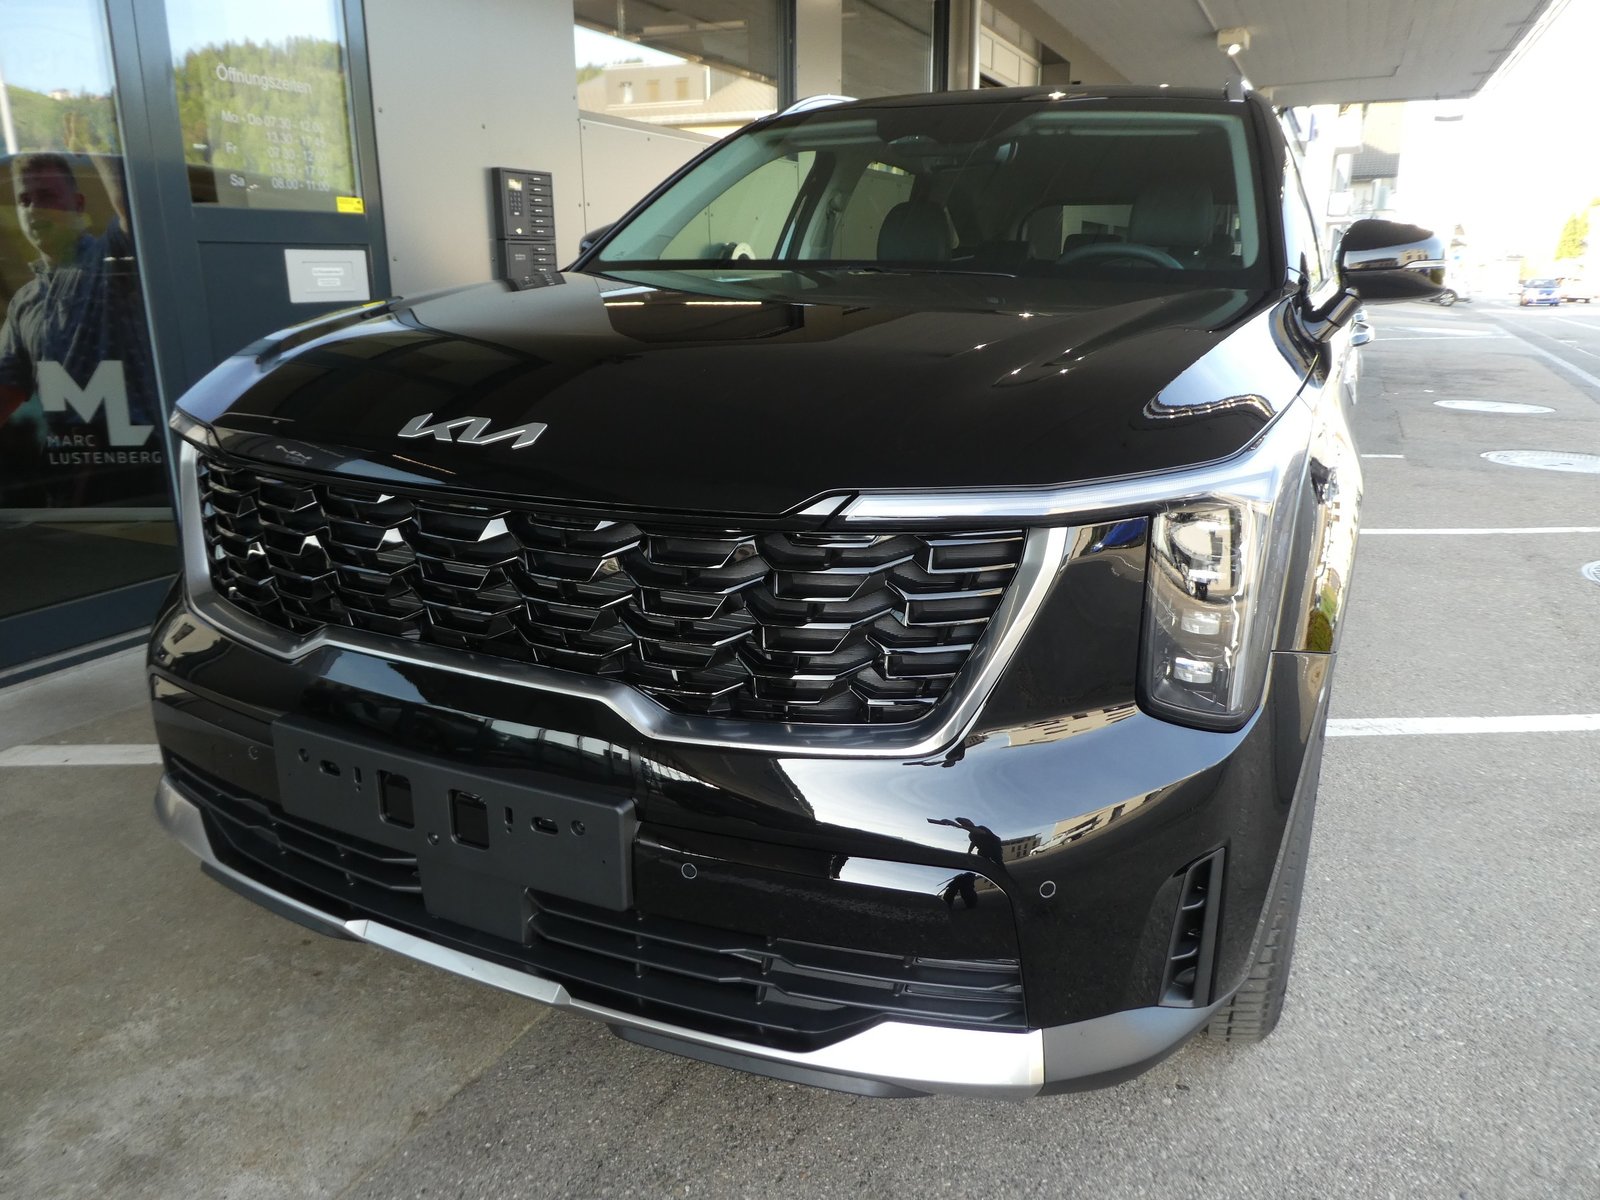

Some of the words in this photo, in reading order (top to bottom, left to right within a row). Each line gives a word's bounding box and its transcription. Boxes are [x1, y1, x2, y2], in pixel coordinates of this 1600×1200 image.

[216, 62, 312, 94] Öffnungszeiten
[221, 109, 240, 123] Mo
[246, 113, 263, 126] Do
[224, 141, 238, 155] Fr
[229, 174, 245, 187] Sa
[37, 360, 155, 446] ML
[397, 412, 548, 450] KIA
[47, 434, 96, 447] MARC
[50, 451, 162, 465] LUSTENBERG
